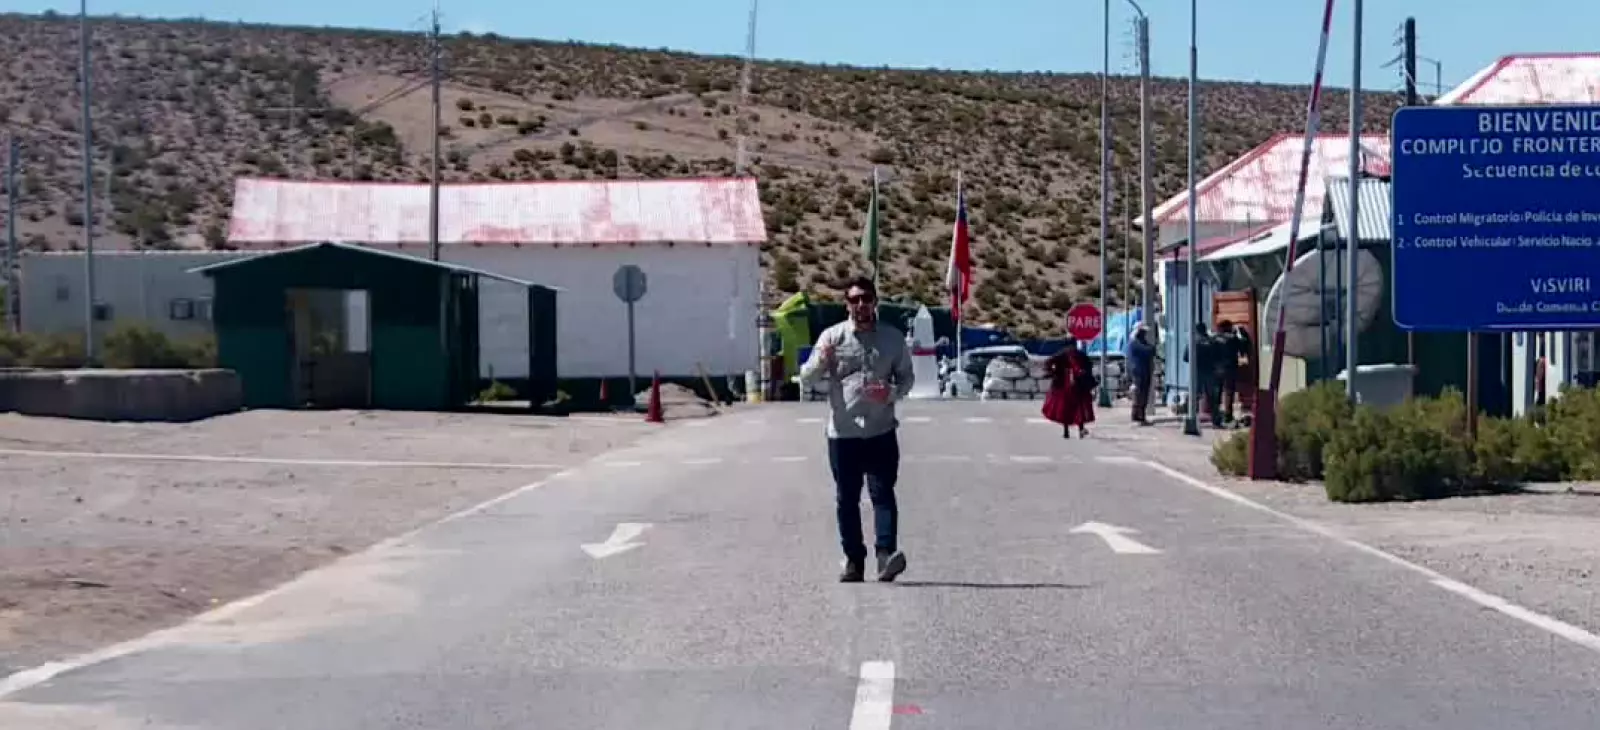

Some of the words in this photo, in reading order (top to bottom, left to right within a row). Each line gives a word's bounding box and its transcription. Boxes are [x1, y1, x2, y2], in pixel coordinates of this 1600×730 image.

[1559, 160, 1582, 178] de
[1414, 212, 1457, 225] Control
[1414, 235, 1457, 248] Control
[1068, 316, 1099, 329] PARE
